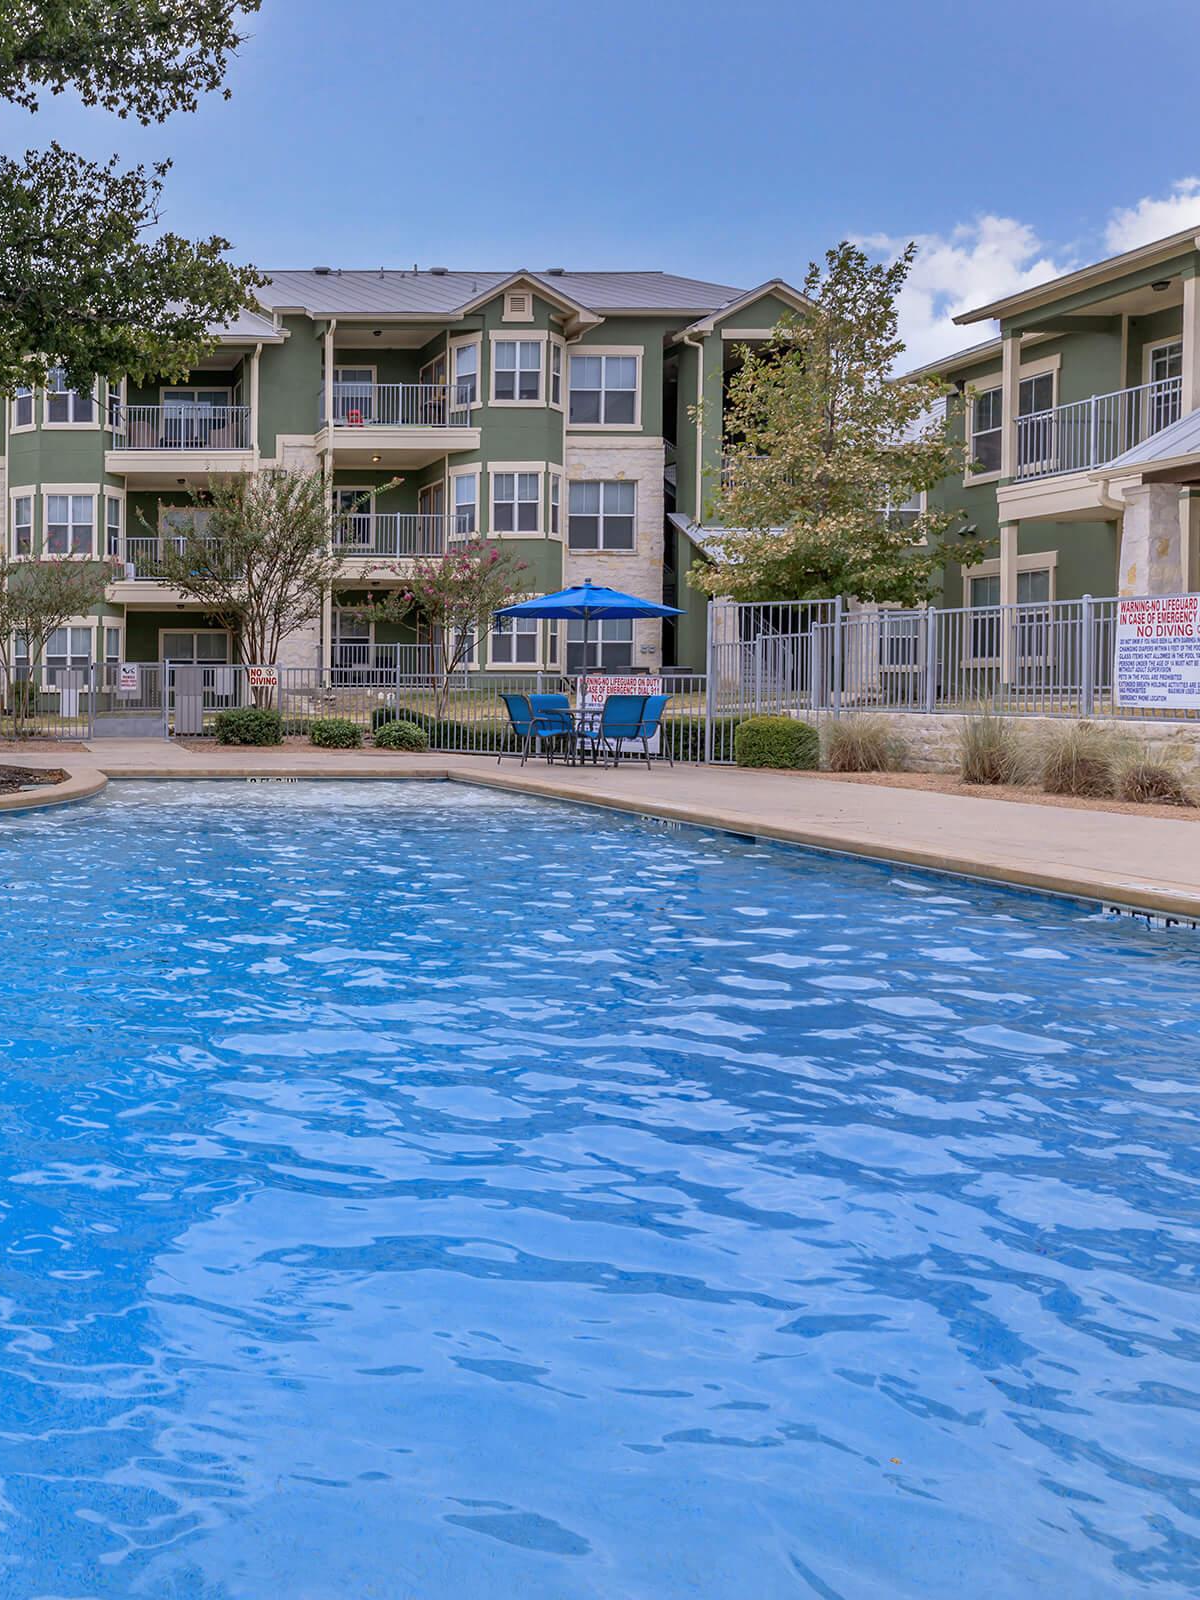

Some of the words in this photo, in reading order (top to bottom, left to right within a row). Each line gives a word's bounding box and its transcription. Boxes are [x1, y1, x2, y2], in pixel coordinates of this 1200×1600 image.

[1162, 598, 1198, 611] LIFEGUARD
[1120, 613, 1127, 625] IN
[1129, 613, 1146, 625] CASE
[1147, 612, 1155, 624] OF
[1157, 611, 1197, 624] EMERGENCY
[1137, 625, 1153, 637] NO
[1156, 624, 1193, 637] DIVING
[251, 668, 262, 677] NO
[251, 676, 277, 686] DIVING
[592, 694, 603, 703] NO
